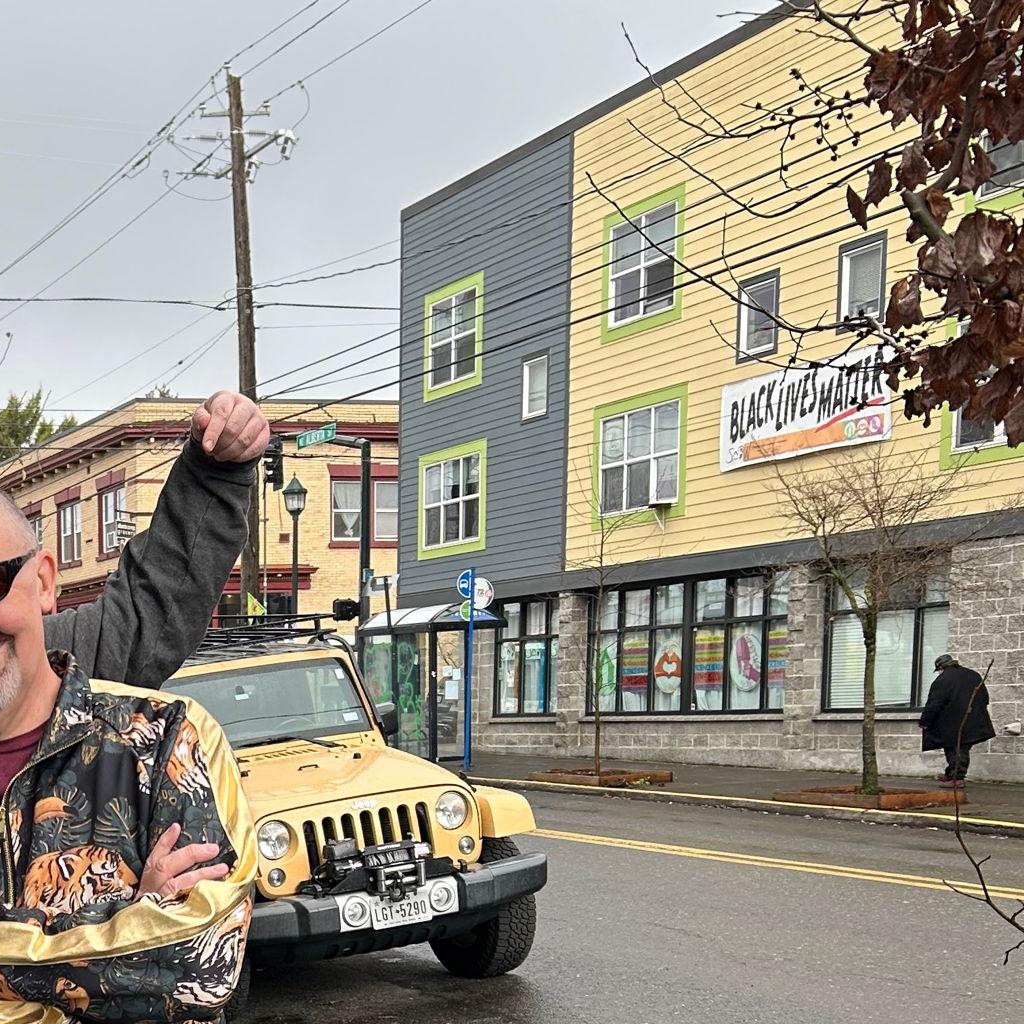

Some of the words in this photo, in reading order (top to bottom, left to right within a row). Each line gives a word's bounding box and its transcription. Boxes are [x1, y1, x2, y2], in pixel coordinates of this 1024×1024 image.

[729, 379, 777, 444] BLACK
[775, 367, 819, 431] LIVES
[816, 350, 884, 424] MATTER
